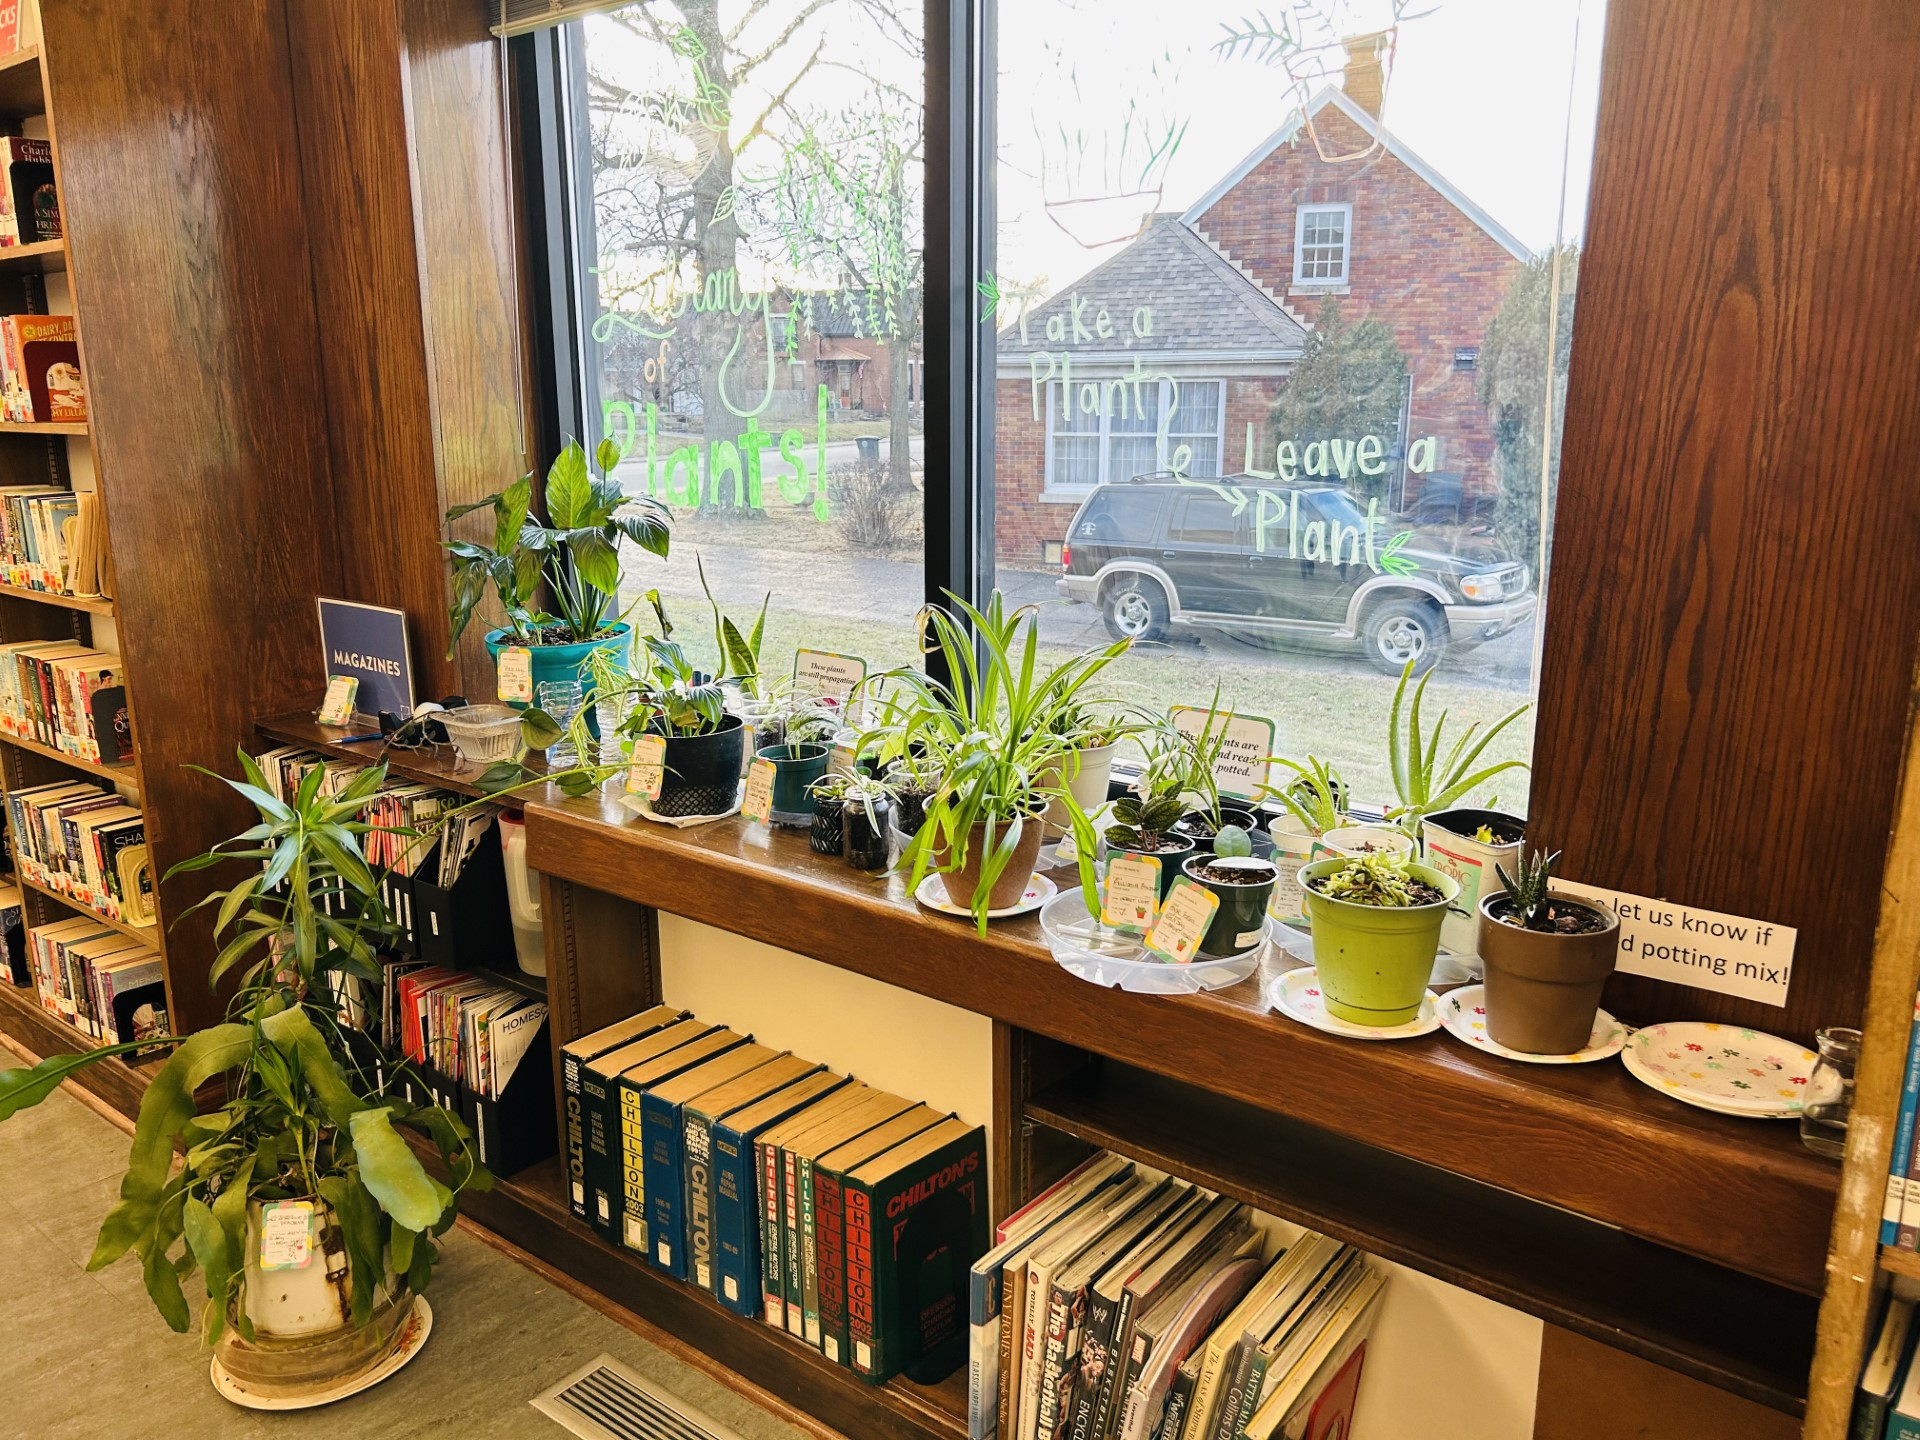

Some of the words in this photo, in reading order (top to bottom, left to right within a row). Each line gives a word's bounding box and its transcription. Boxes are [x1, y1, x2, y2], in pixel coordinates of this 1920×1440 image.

[1007, 290, 1114, 346] Take
[1132, 305, 1153, 339] a
[643, 339, 671, 383] of
[1029, 351, 1153, 422] Plant
[602, 383, 830, 522] Plants!
[1244, 421, 1388, 482] Leave
[1407, 435, 1437, 474] a
[1255, 488, 1388, 575] Plant
[334, 649, 401, 677] MAGAZINES
[808, 671, 820, 679] still
[811, 662, 826, 671] These
[826, 665, 846, 675] plants
[1207, 735, 1240, 748] plnts
[1241, 742, 1260, 751] are
[1216, 750, 1231, 760] nd
[1614, 897, 1642, 921] let
[1648, 910, 1673, 928] us
[1682, 912, 1748, 941] know
[1755, 927, 1774, 947] if
[1641, 941, 1728, 976] potting
[1735, 960, 1789, 986] mix!
[624, 1090, 641, 1201] CHILTON
[625, 1198, 644, 1213] 2003
[766, 1145, 777, 1222] CHILTON
[785, 1152, 797, 1230] CHILTON
[801, 1158, 812, 1233] CHILTON
[886, 1151, 979, 1218] CHILTON'S
[691, 1164, 710, 1269] CHILTON
[820, 1178, 837, 1300] CHILTON
[851, 1191, 867, 1318] CHILTON
[1002, 1280, 1013, 1309] TINY
[850, 1315, 872, 1336] 2002
[1001, 1313, 1012, 1359] HOMES
[1049, 1301, 1069, 1336] The
[1025, 1324, 1036, 1360] MAD
[1210, 1351, 1220, 1367] The
[971, 1361, 980, 1387] CLASSIC
[1000, 1369, 1009, 1396] Simple
[1039, 1336, 1062, 1429] Basketball
[1094, 1348, 1119, 1438] BASKETBALL
[1201, 1368, 1214, 1397] ATLAS
[1242, 1368, 1261, 1409] BATTLE
[1222, 1387, 1243, 1427] Collins
